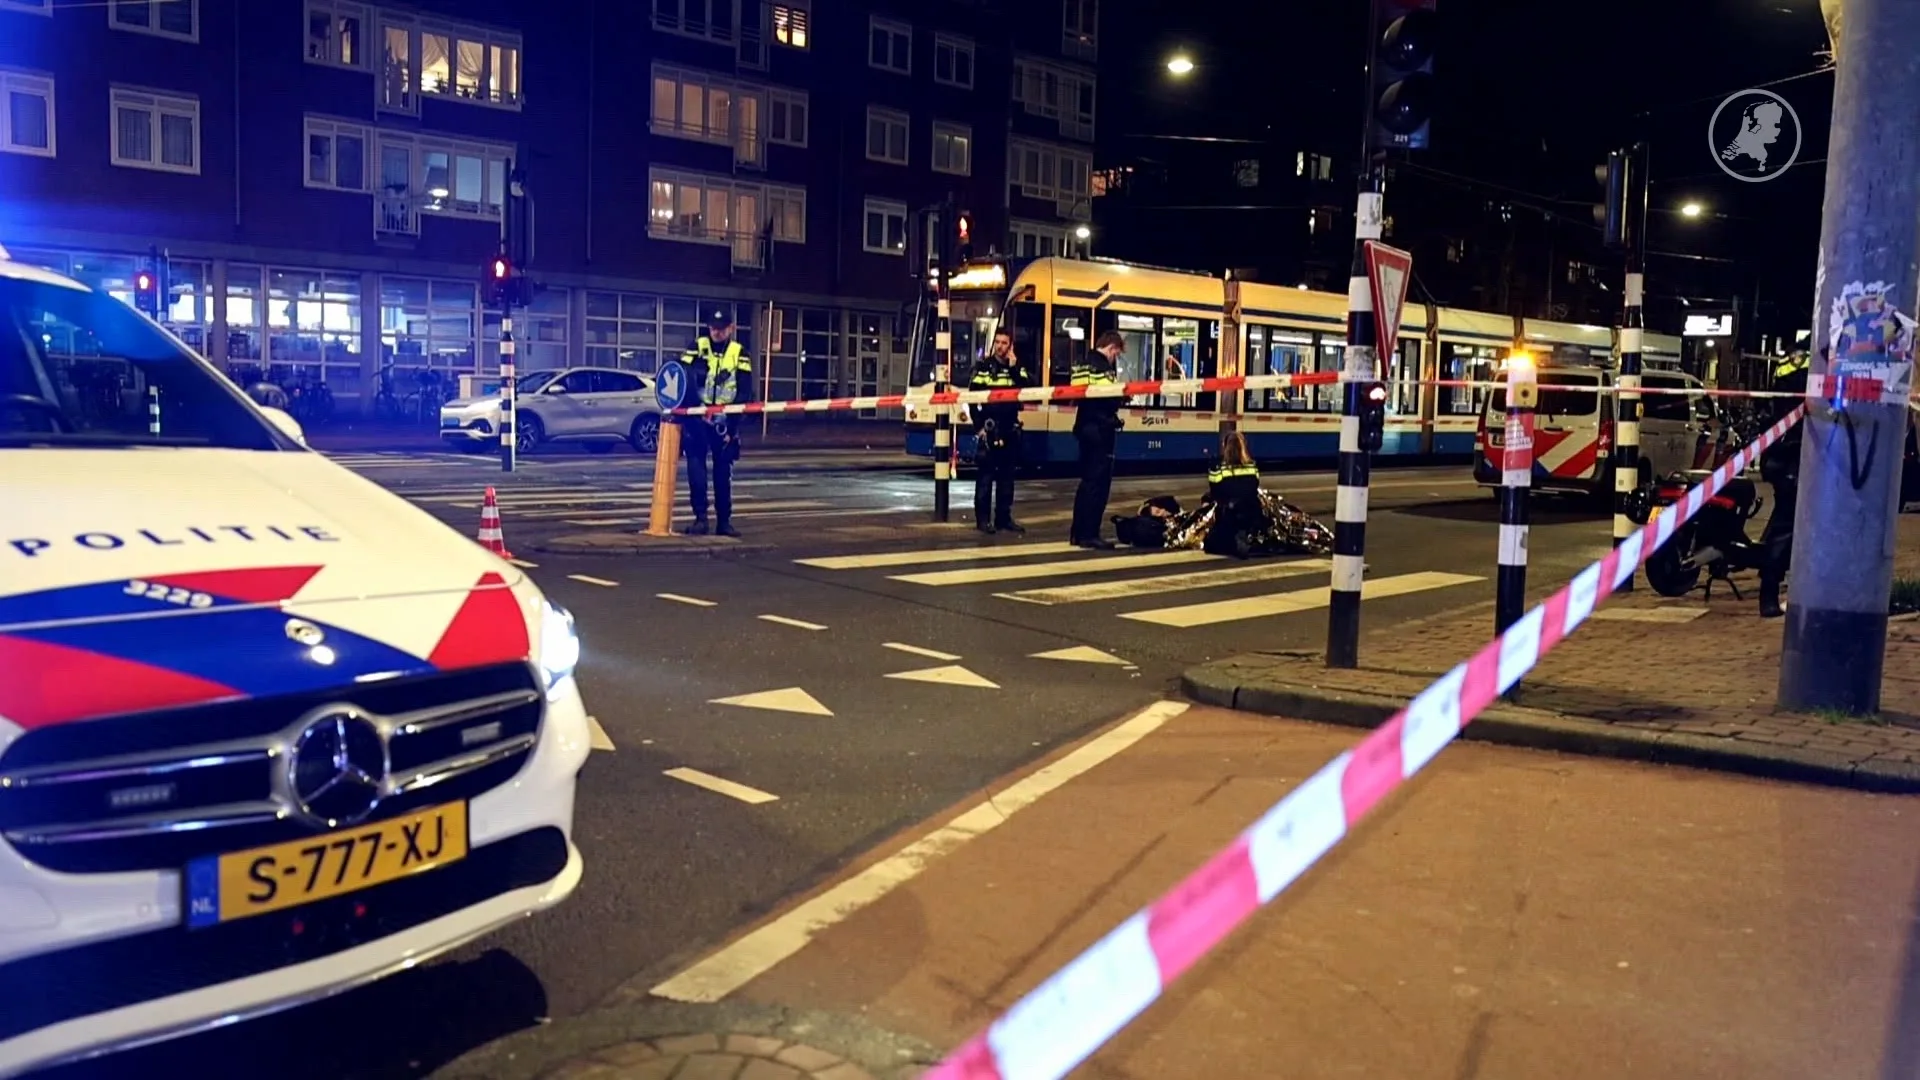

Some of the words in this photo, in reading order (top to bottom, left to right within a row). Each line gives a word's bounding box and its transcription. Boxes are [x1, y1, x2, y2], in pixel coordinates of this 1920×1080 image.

[8, 525, 340, 557] POLITIE
[246, 814, 445, 904] S-777-XJ
[192, 897, 215, 916] NL
